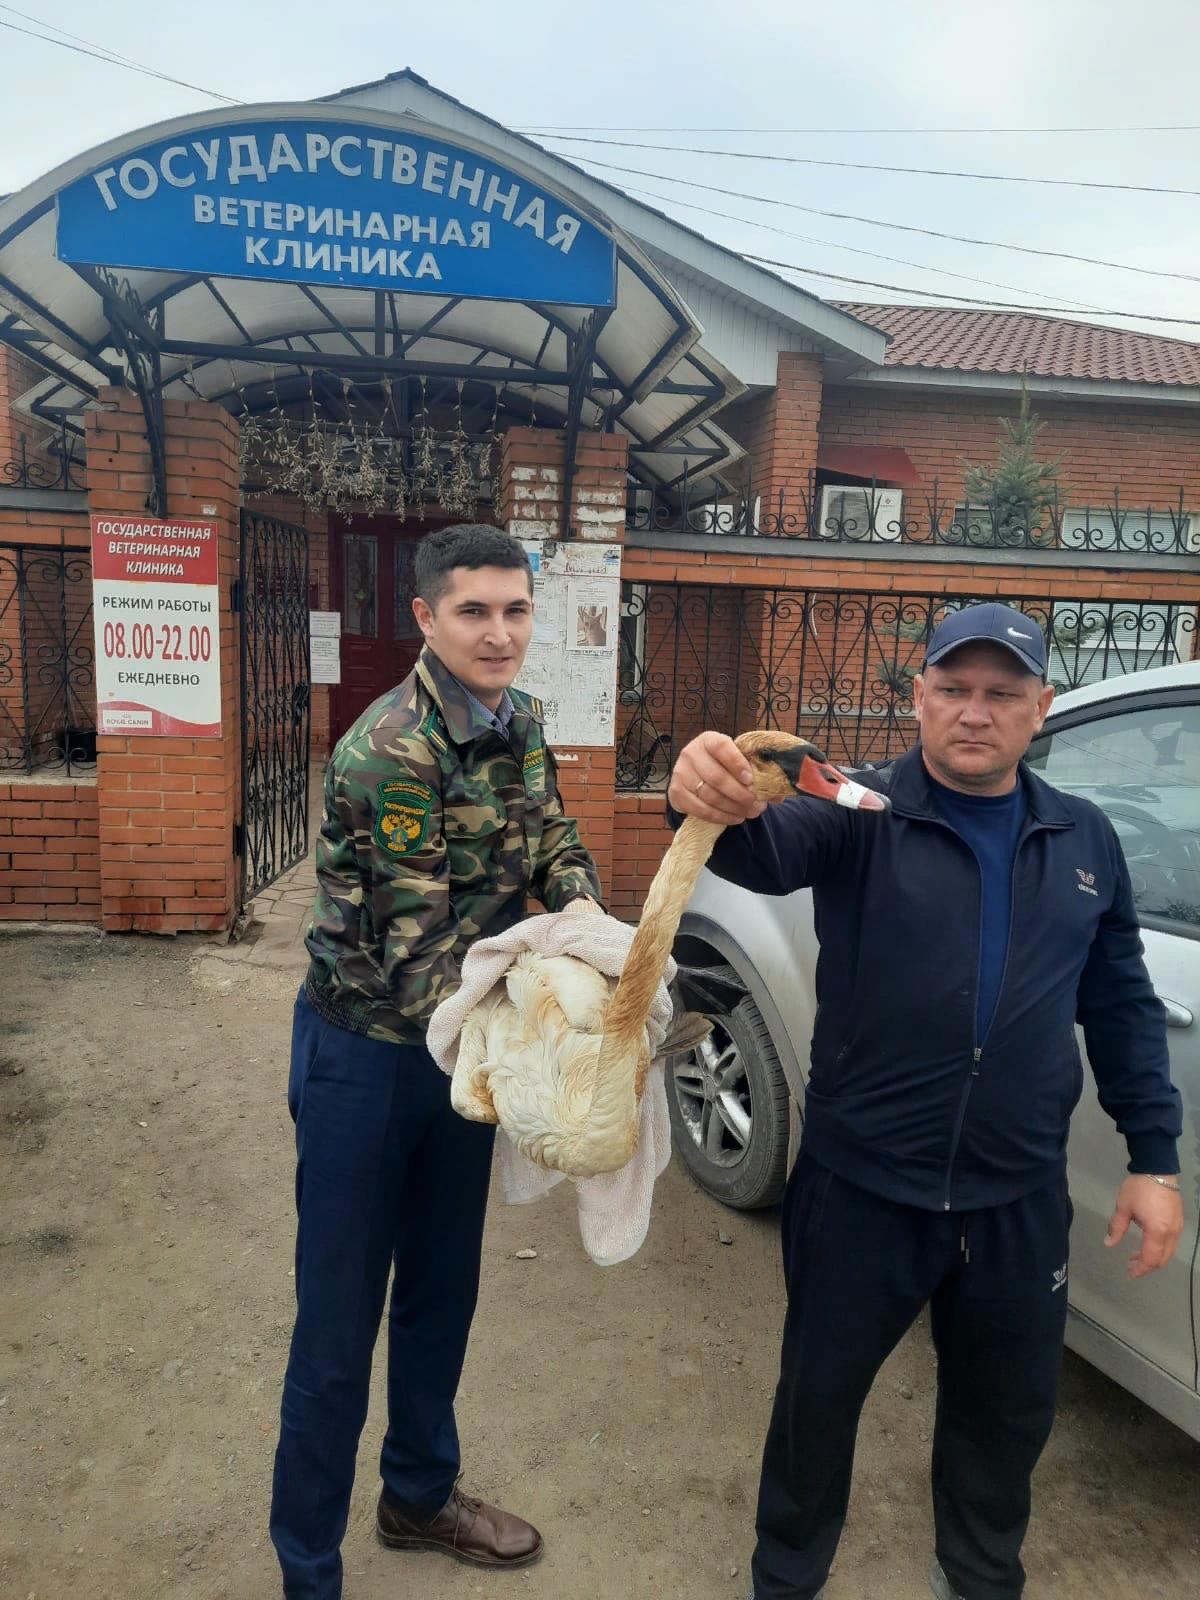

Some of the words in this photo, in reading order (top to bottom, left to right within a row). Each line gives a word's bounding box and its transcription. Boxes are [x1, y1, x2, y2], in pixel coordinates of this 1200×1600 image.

[92, 132, 581, 254] ГОСУДАРСТВЕННАЯ
[193, 193, 491, 249] ВЕТЕРИНАРНАЯ
[245, 236, 442, 281] КЛИНИКА
[97, 521, 211, 540] ГОСУДАРСТВЕННАЯ
[108, 541, 201, 558] ВЕТЕРИНАРНАЯ
[126, 561, 184, 576] КЛИНИКА
[102, 596, 154, 610] РЕЖИМ
[157, 598, 211, 613] РАБОТЫ
[103, 621, 211, 662] 08.00-22.00
[117, 671, 200, 687] ЕЖЕДНЕВНО
